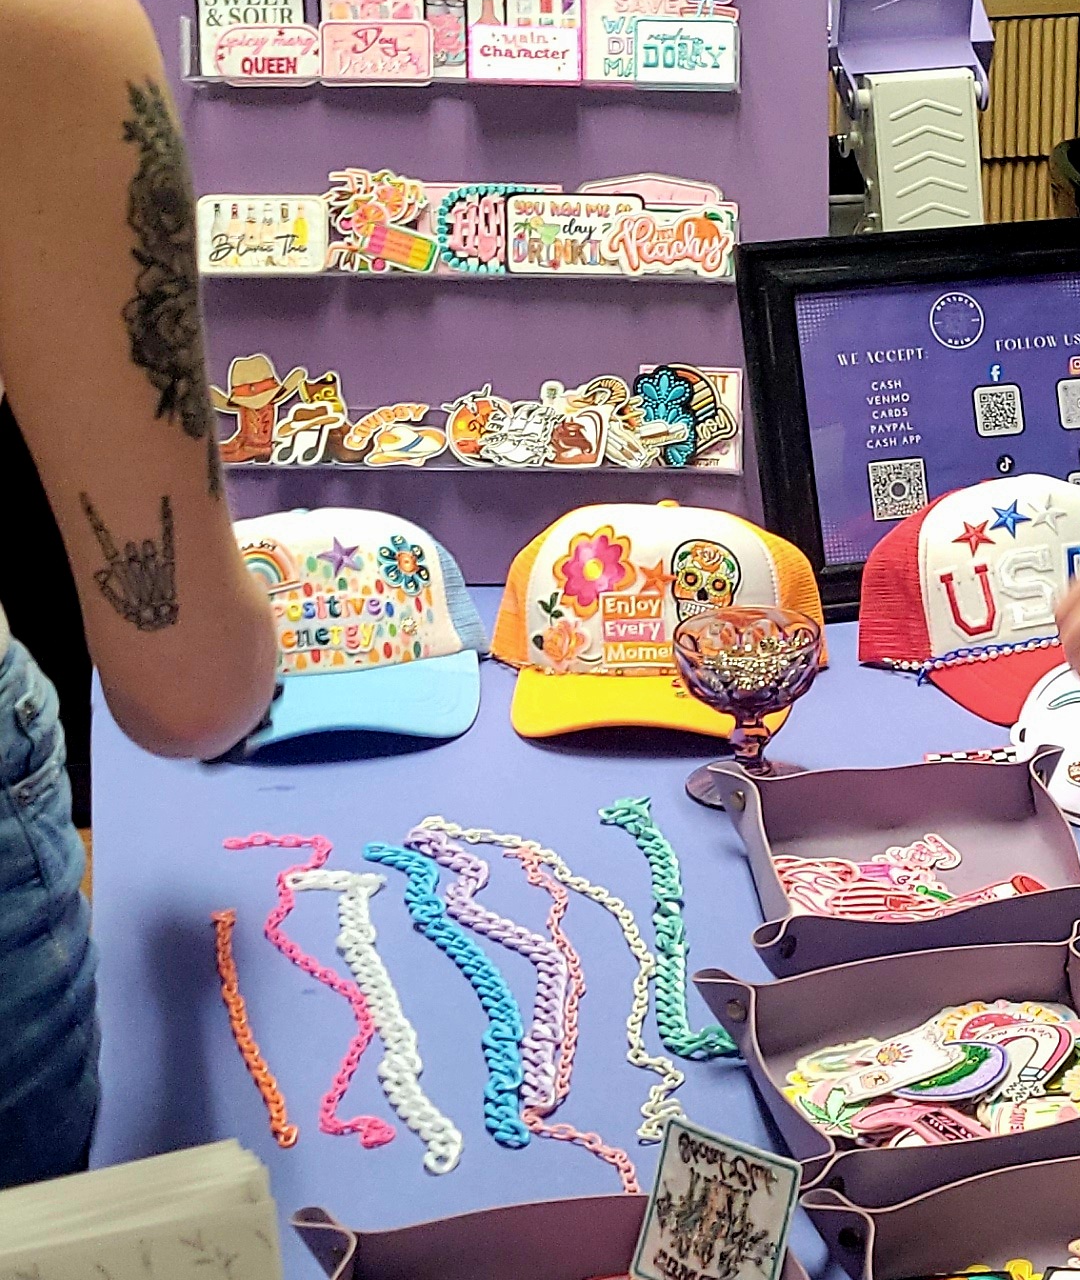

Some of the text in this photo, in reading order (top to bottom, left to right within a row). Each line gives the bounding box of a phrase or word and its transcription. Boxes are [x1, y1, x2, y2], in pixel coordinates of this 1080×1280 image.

[206, 8, 293, 27] & SOUR
[480, 44, 570, 61] Character
[241, 56, 297, 75] QUEEN
[562, 218, 597, 244] day
[609, 217, 729, 272] Peachy
[995, 336, 1058, 352] FOLLOW
[837, 351, 860, 366] WE
[871, 379, 902, 391] CASH
[866, 393, 910, 406] VENMO
[872, 407, 908, 419] CARDS
[346, 405, 427, 448] COWBOY
[870, 421, 913, 434] PAYPAL
[866, 434, 922, 450] CASH APP
[604, 598, 661, 618] Enjoy
[281, 622, 376, 650] energy
[604, 620, 661, 640] Every
[606, 644, 673, 662] Mome
